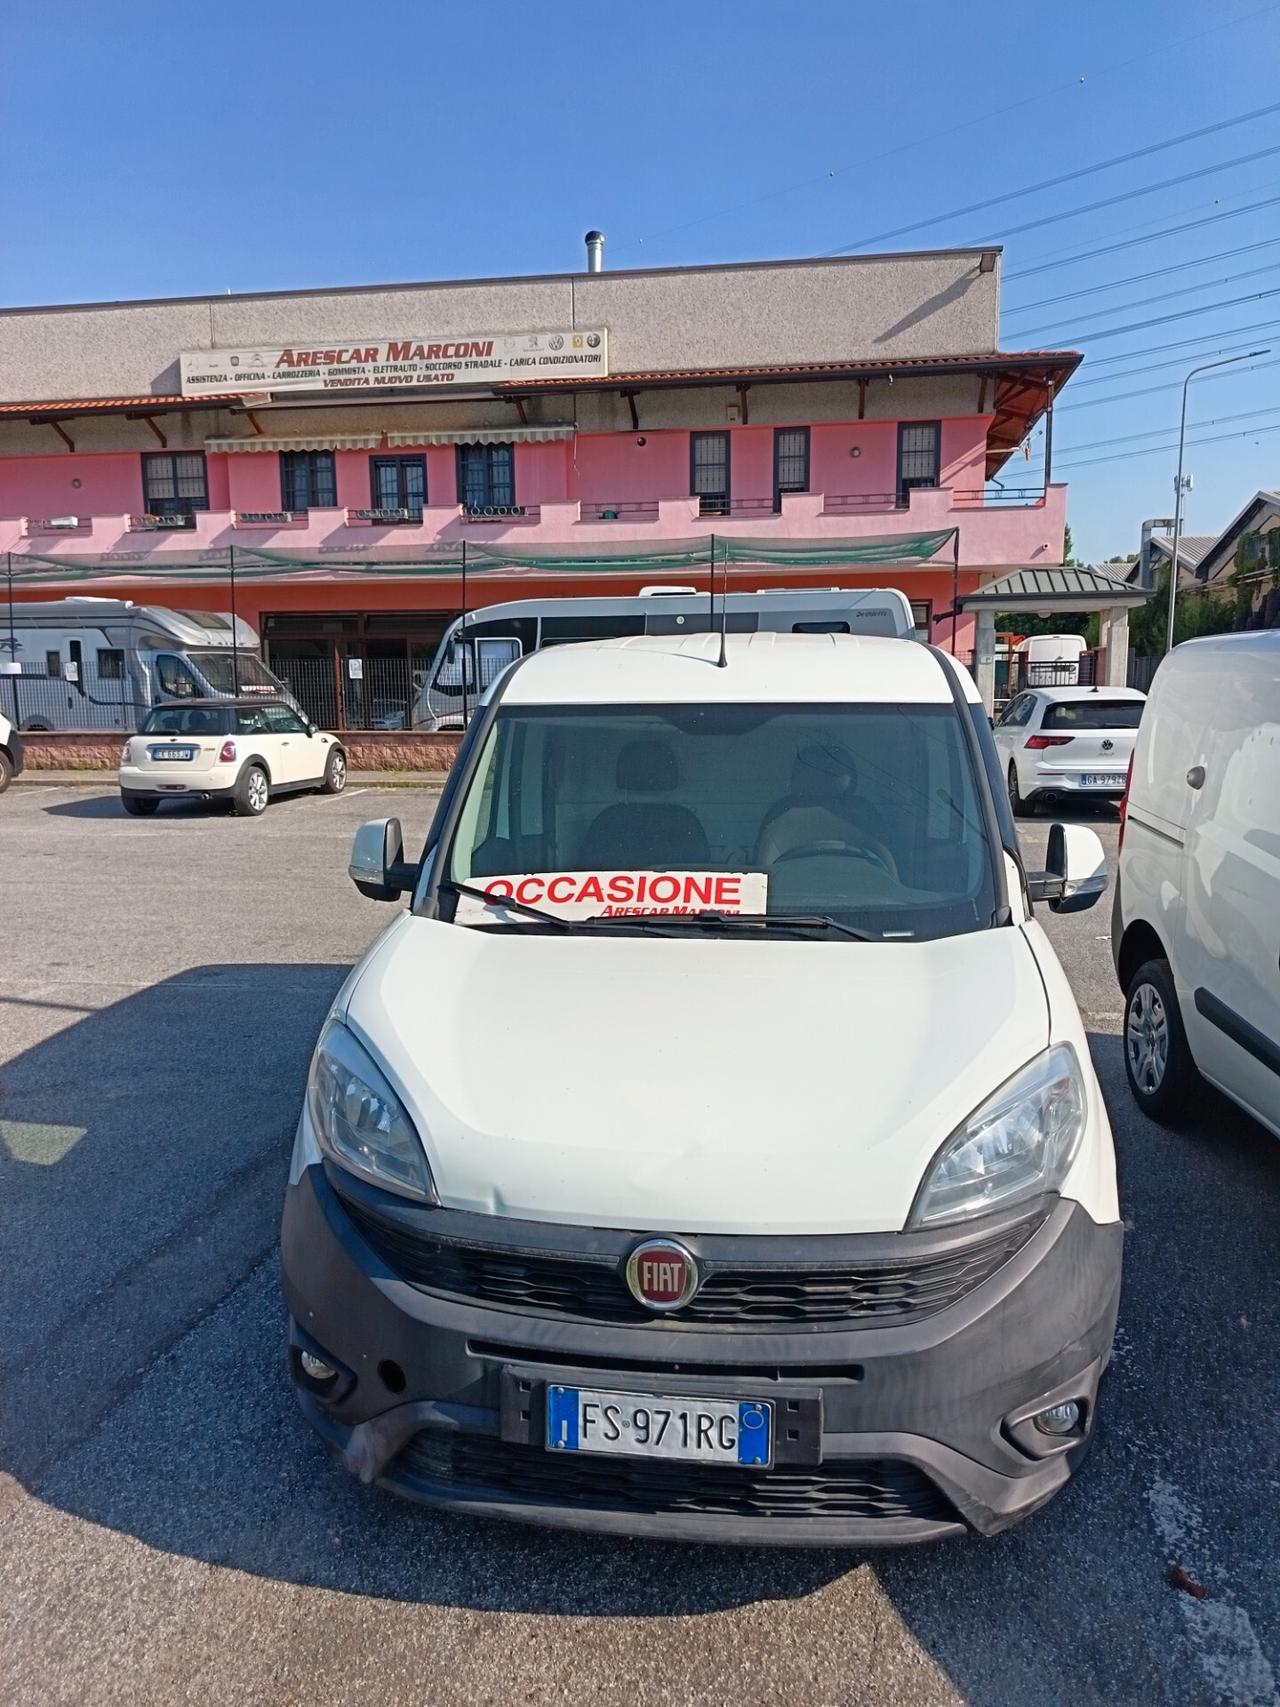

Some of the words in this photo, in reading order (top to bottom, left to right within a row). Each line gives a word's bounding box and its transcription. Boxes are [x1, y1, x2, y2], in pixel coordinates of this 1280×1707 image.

[186, 374, 228, 384] ASSISTENZA
[235, 372, 266, 382] OFFICINA
[272, 369, 321, 380] CARROZZERIA
[328, 366, 366, 376] GOMMISTA
[373, 364, 418, 374] ELETTRAUTO
[425, 362, 462, 371] SOCCORSO
[464, 359, 503, 369] STRADALE
[510, 357, 536, 367] CARICA
[539, 354, 602, 365] CONDIZIONATORI
[275, 348, 379, 368] ARESCAR
[386, 341, 494, 361] MARCONI
[323, 377, 370, 388] VENDITA
[373, 374, 413, 385] NUOVO
[417, 373, 455, 383] USATO
[484, 876, 741, 906] OCCASIONE
[643, 1261, 682, 1292] FIAT
[582, 1402, 621, 1441] FS
[632, 1408, 736, 1450] 971RG
